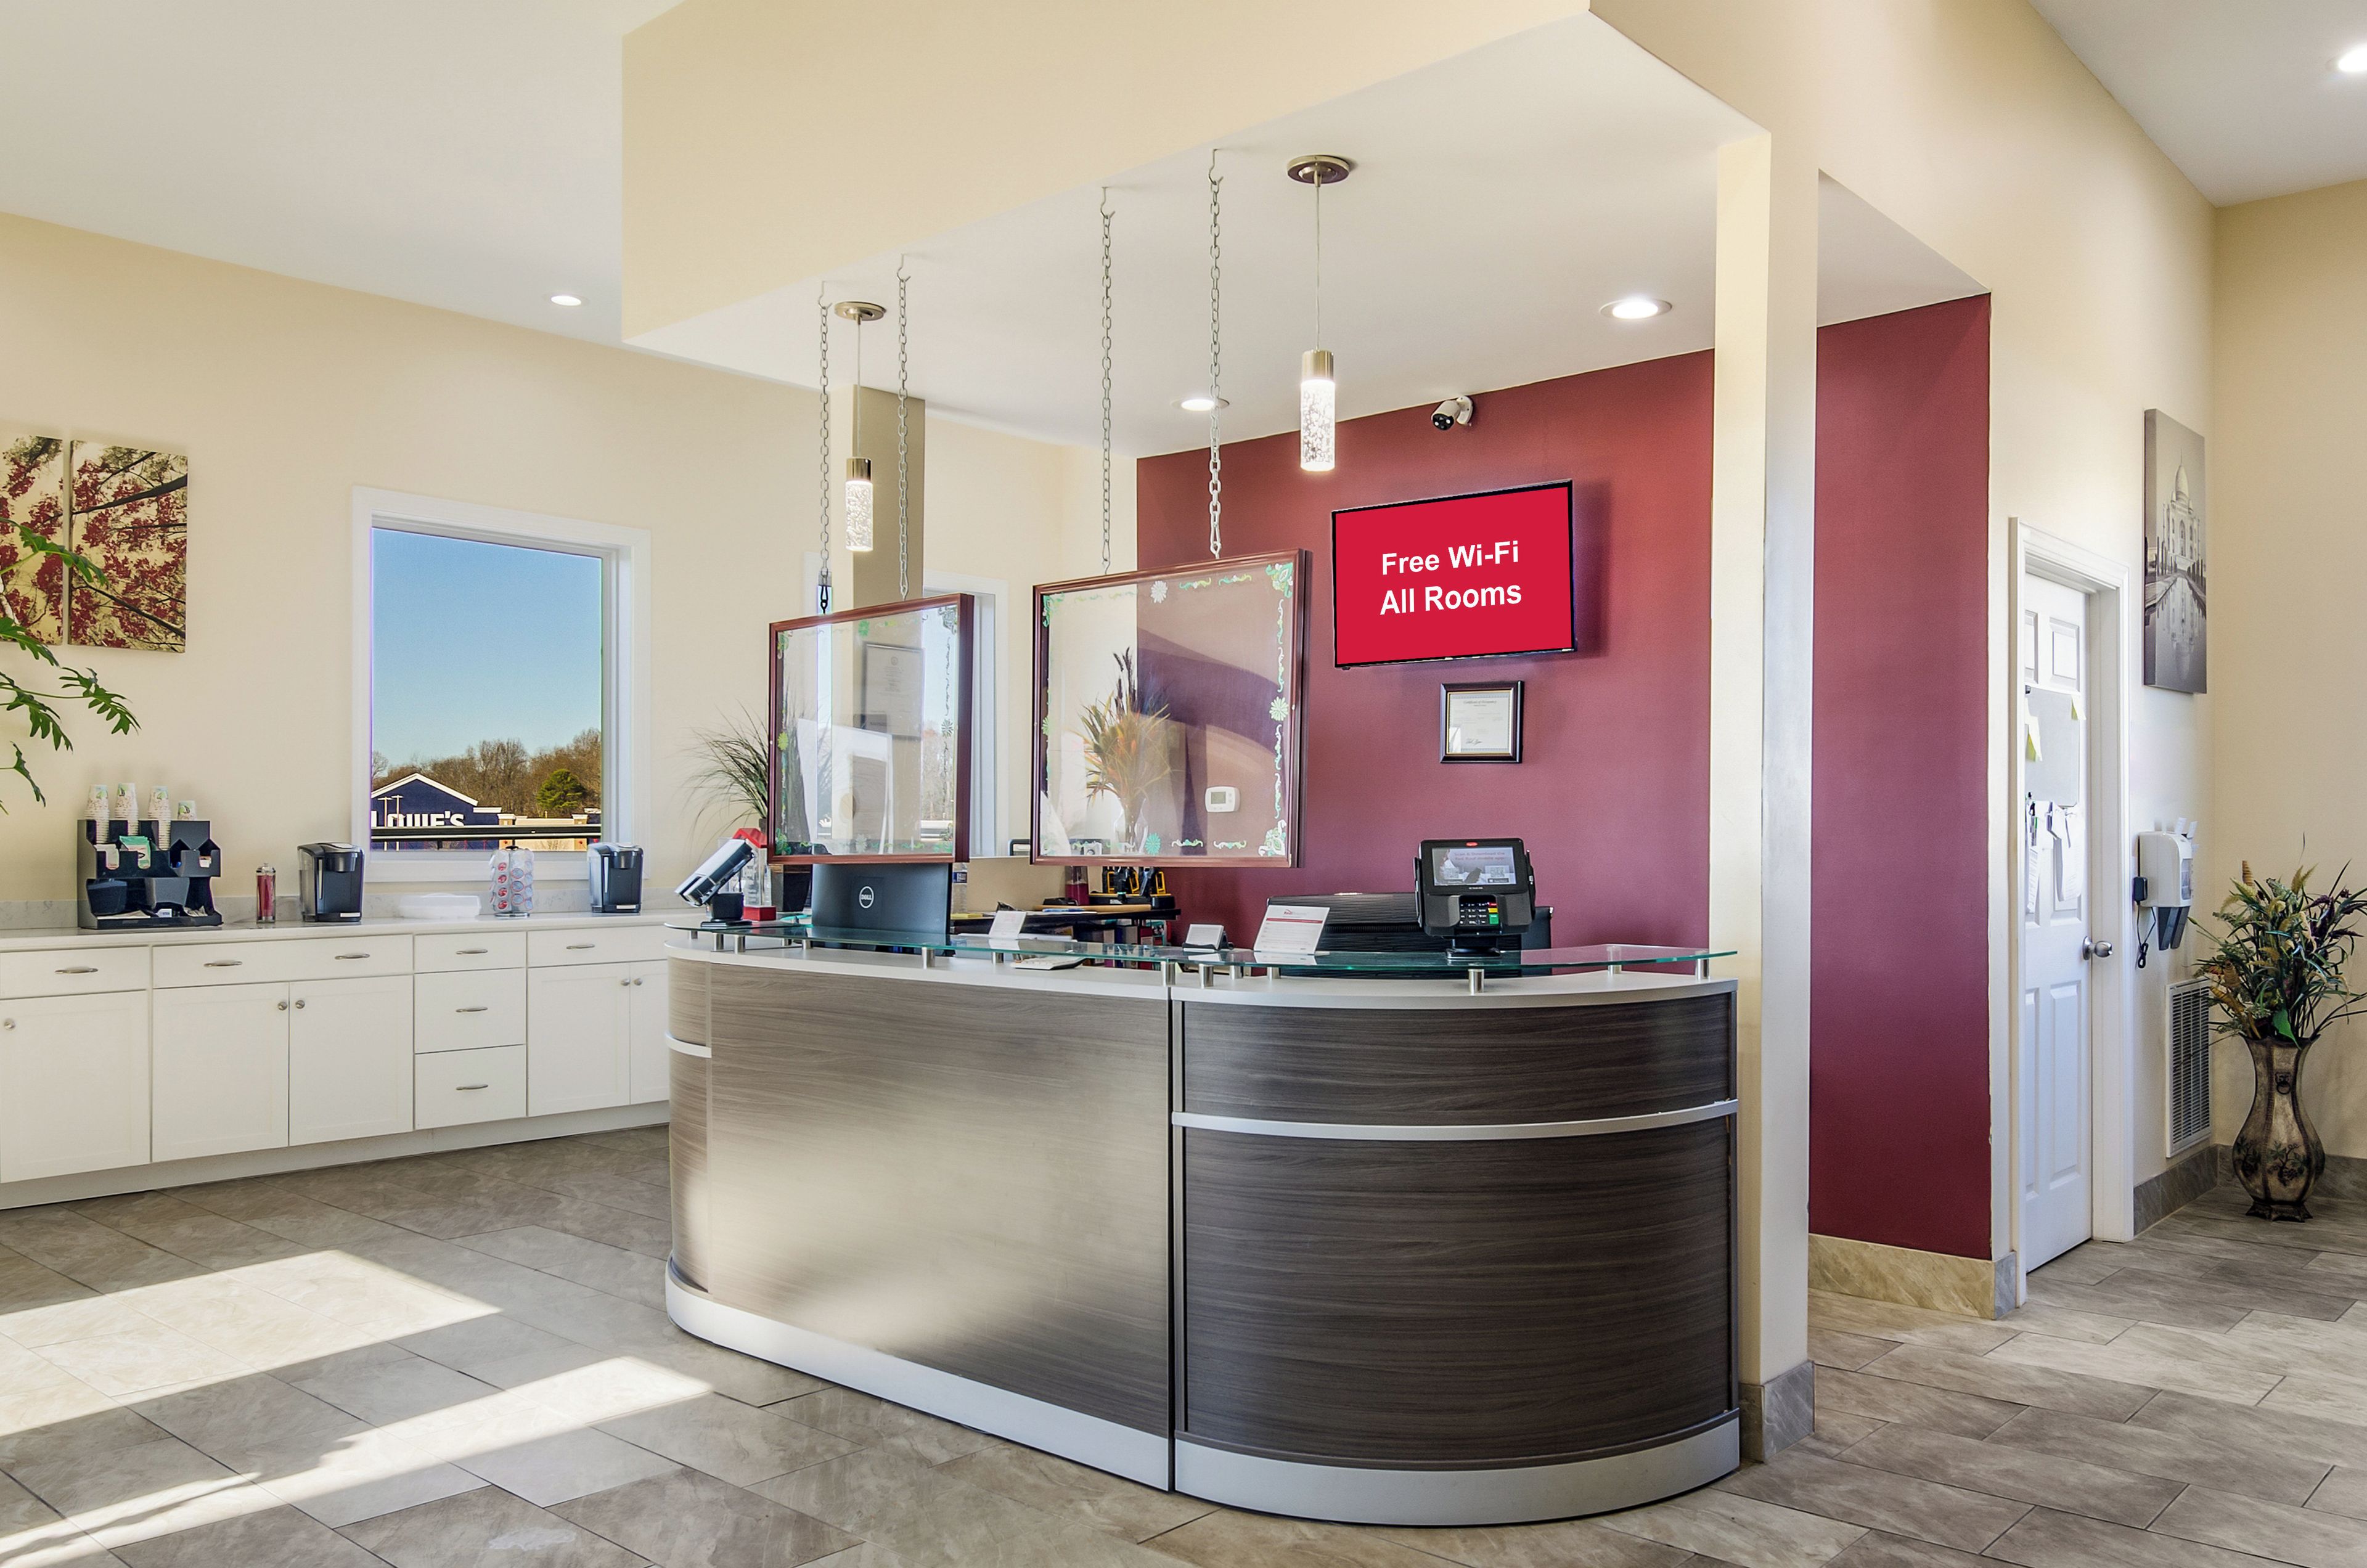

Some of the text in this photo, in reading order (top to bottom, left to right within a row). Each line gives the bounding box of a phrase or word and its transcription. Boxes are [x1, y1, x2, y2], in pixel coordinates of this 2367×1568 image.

[1383, 541, 1518, 575] Free Wi-Fi
[1380, 585, 1521, 615] All Rooms
